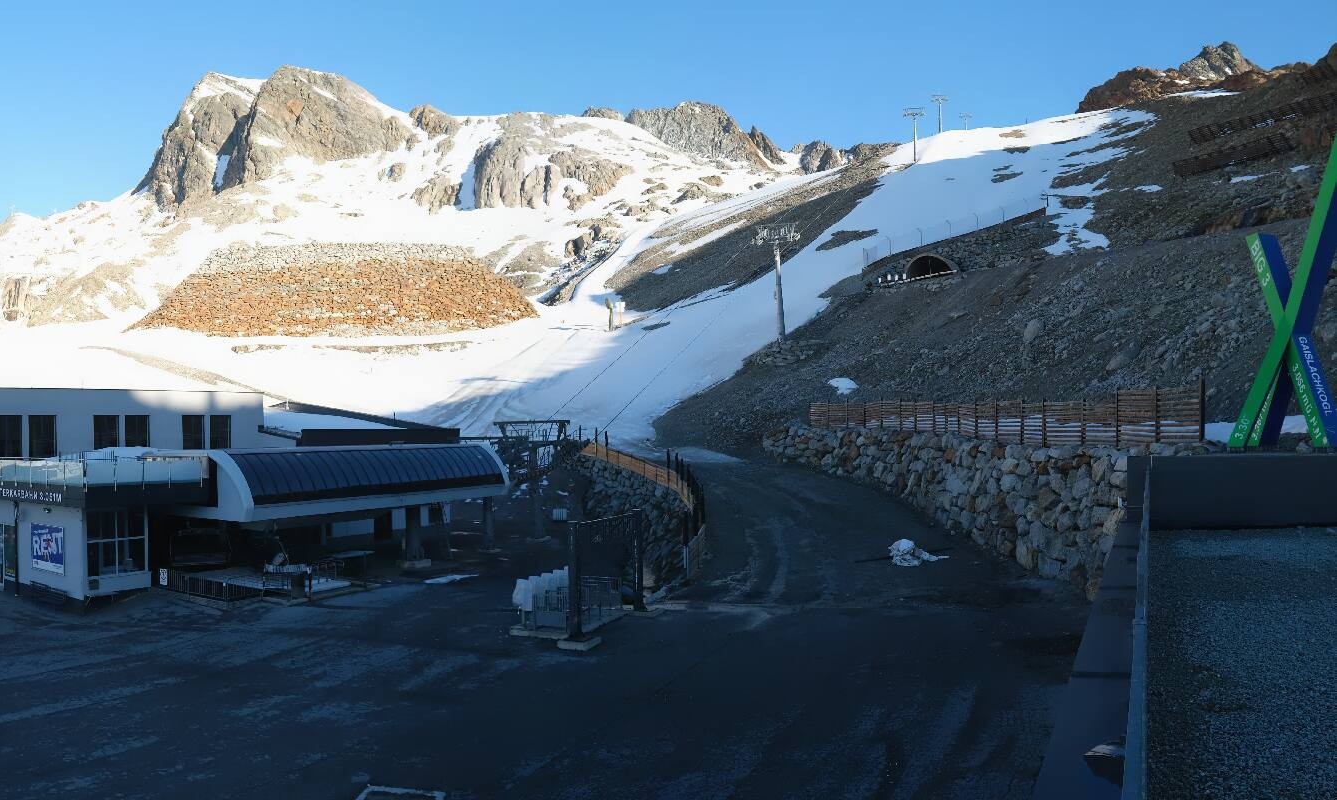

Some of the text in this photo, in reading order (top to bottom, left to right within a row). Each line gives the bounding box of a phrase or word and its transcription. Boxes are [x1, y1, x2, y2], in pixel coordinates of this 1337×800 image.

[1250, 239, 1271, 287] BIG 3
[1298, 336, 1333, 417] GAISLACHKOGL
[32, 532, 64, 555] RENT
